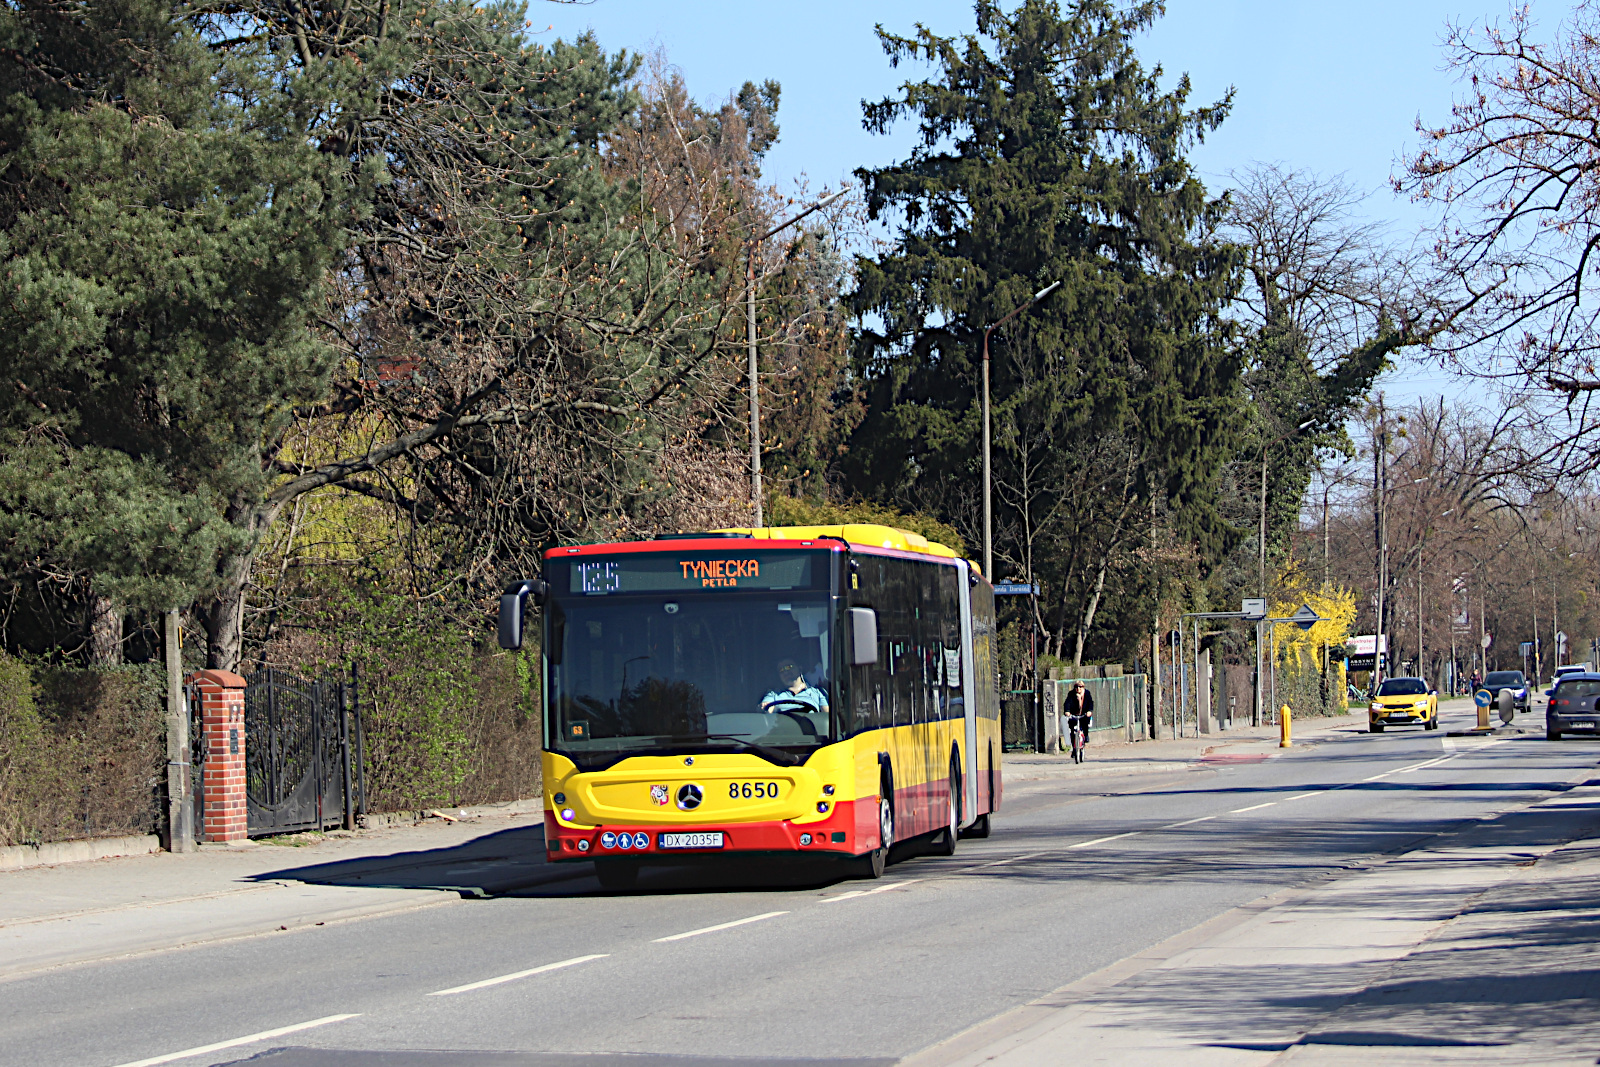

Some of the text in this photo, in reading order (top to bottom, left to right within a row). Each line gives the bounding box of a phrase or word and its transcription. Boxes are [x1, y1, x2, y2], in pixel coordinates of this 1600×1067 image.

[578, 562, 619, 592] 125
[679, 559, 759, 579] TYNIECKA
[573, 725, 583, 735] 63
[728, 782, 779, 799] 8650
[666, 834, 720, 846] DX 2035F
